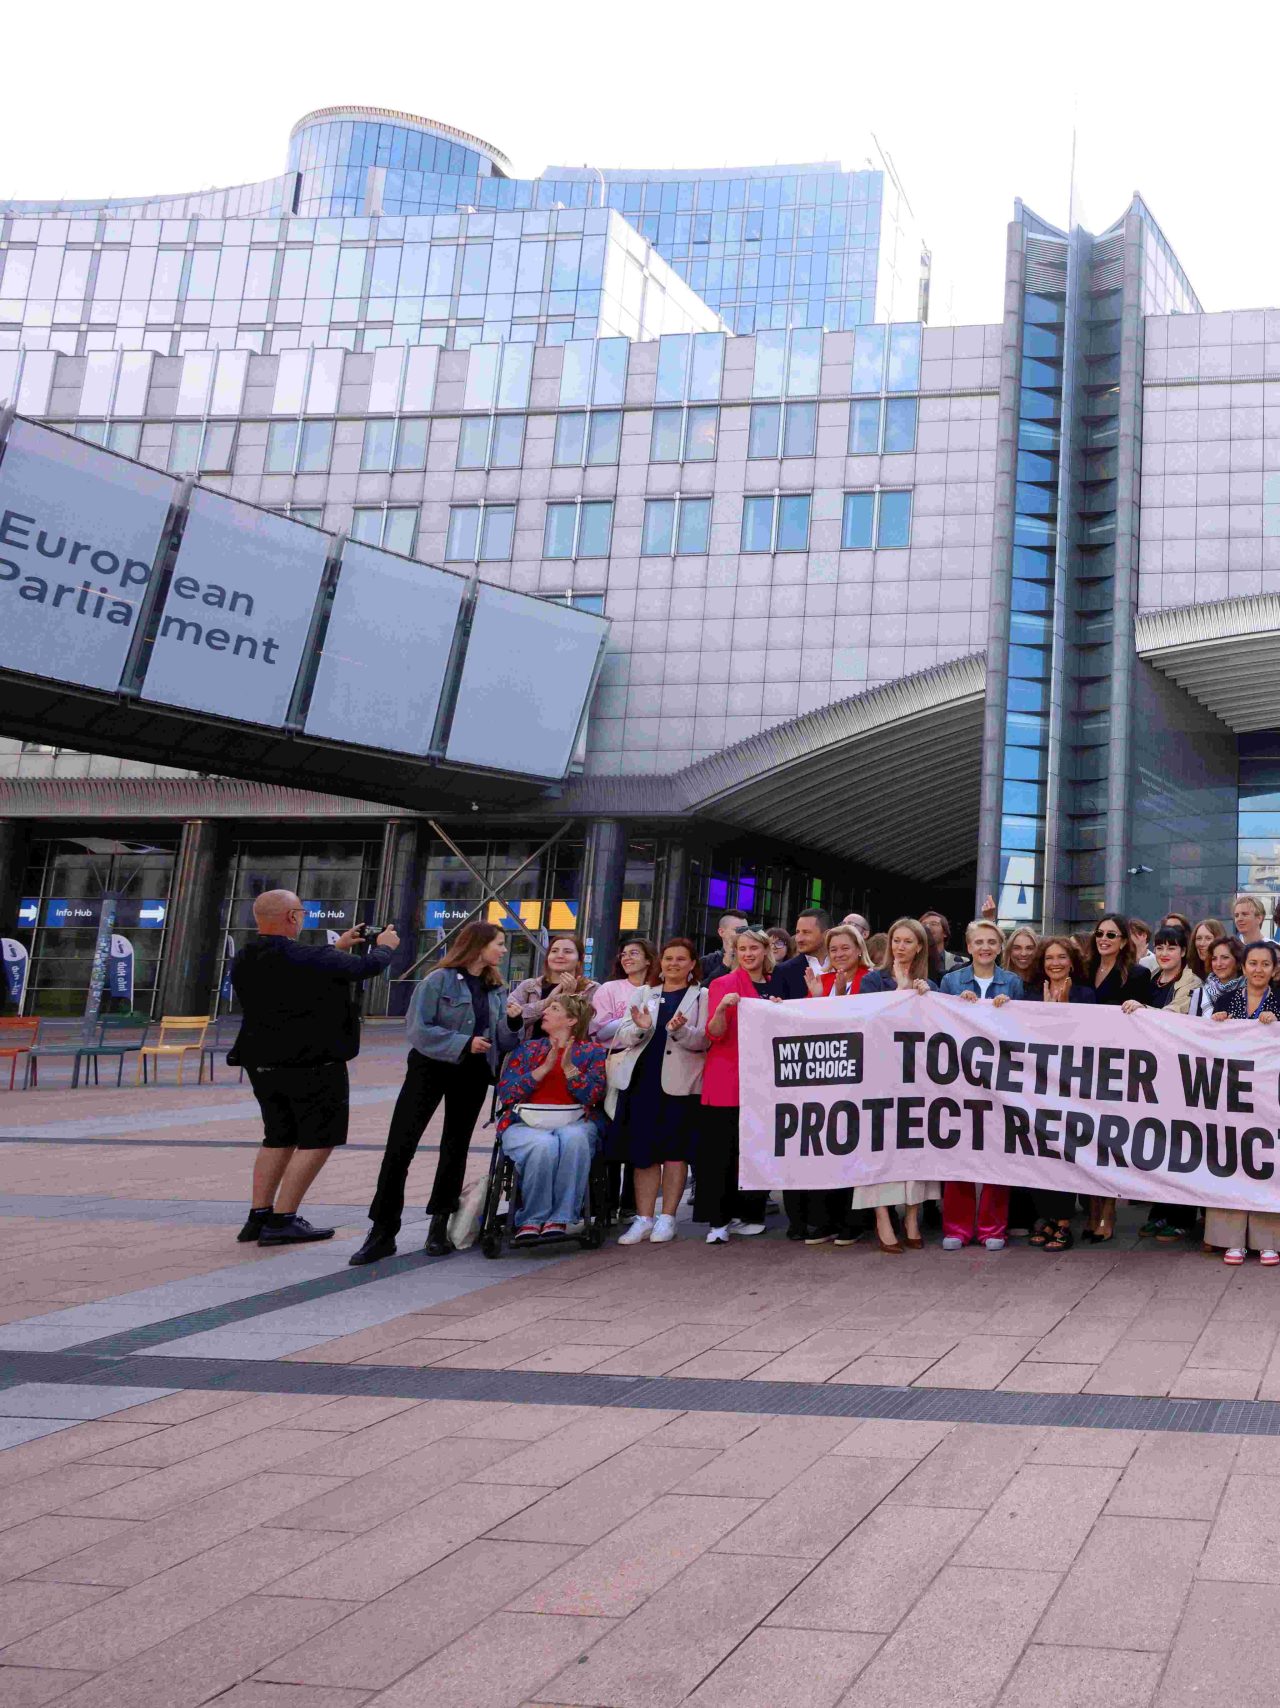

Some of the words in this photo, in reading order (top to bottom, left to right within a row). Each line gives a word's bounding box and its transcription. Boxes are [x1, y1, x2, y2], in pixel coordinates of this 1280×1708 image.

[0, 510, 254, 616] European
[56, 909, 72, 917] Info
[74, 909, 92, 917] Hub
[434, 911, 450, 919] Info
[778, 1042, 801, 1061] MY
[804, 1040, 848, 1060] VOICE
[780, 1062, 802, 1081] MY
[805, 1059, 856, 1079] CHOICE
[893, 1031, 1159, 1105] TOGETHER
[1177, 1053, 1255, 1114] WE
[774, 1096, 994, 1158] PROTECT
